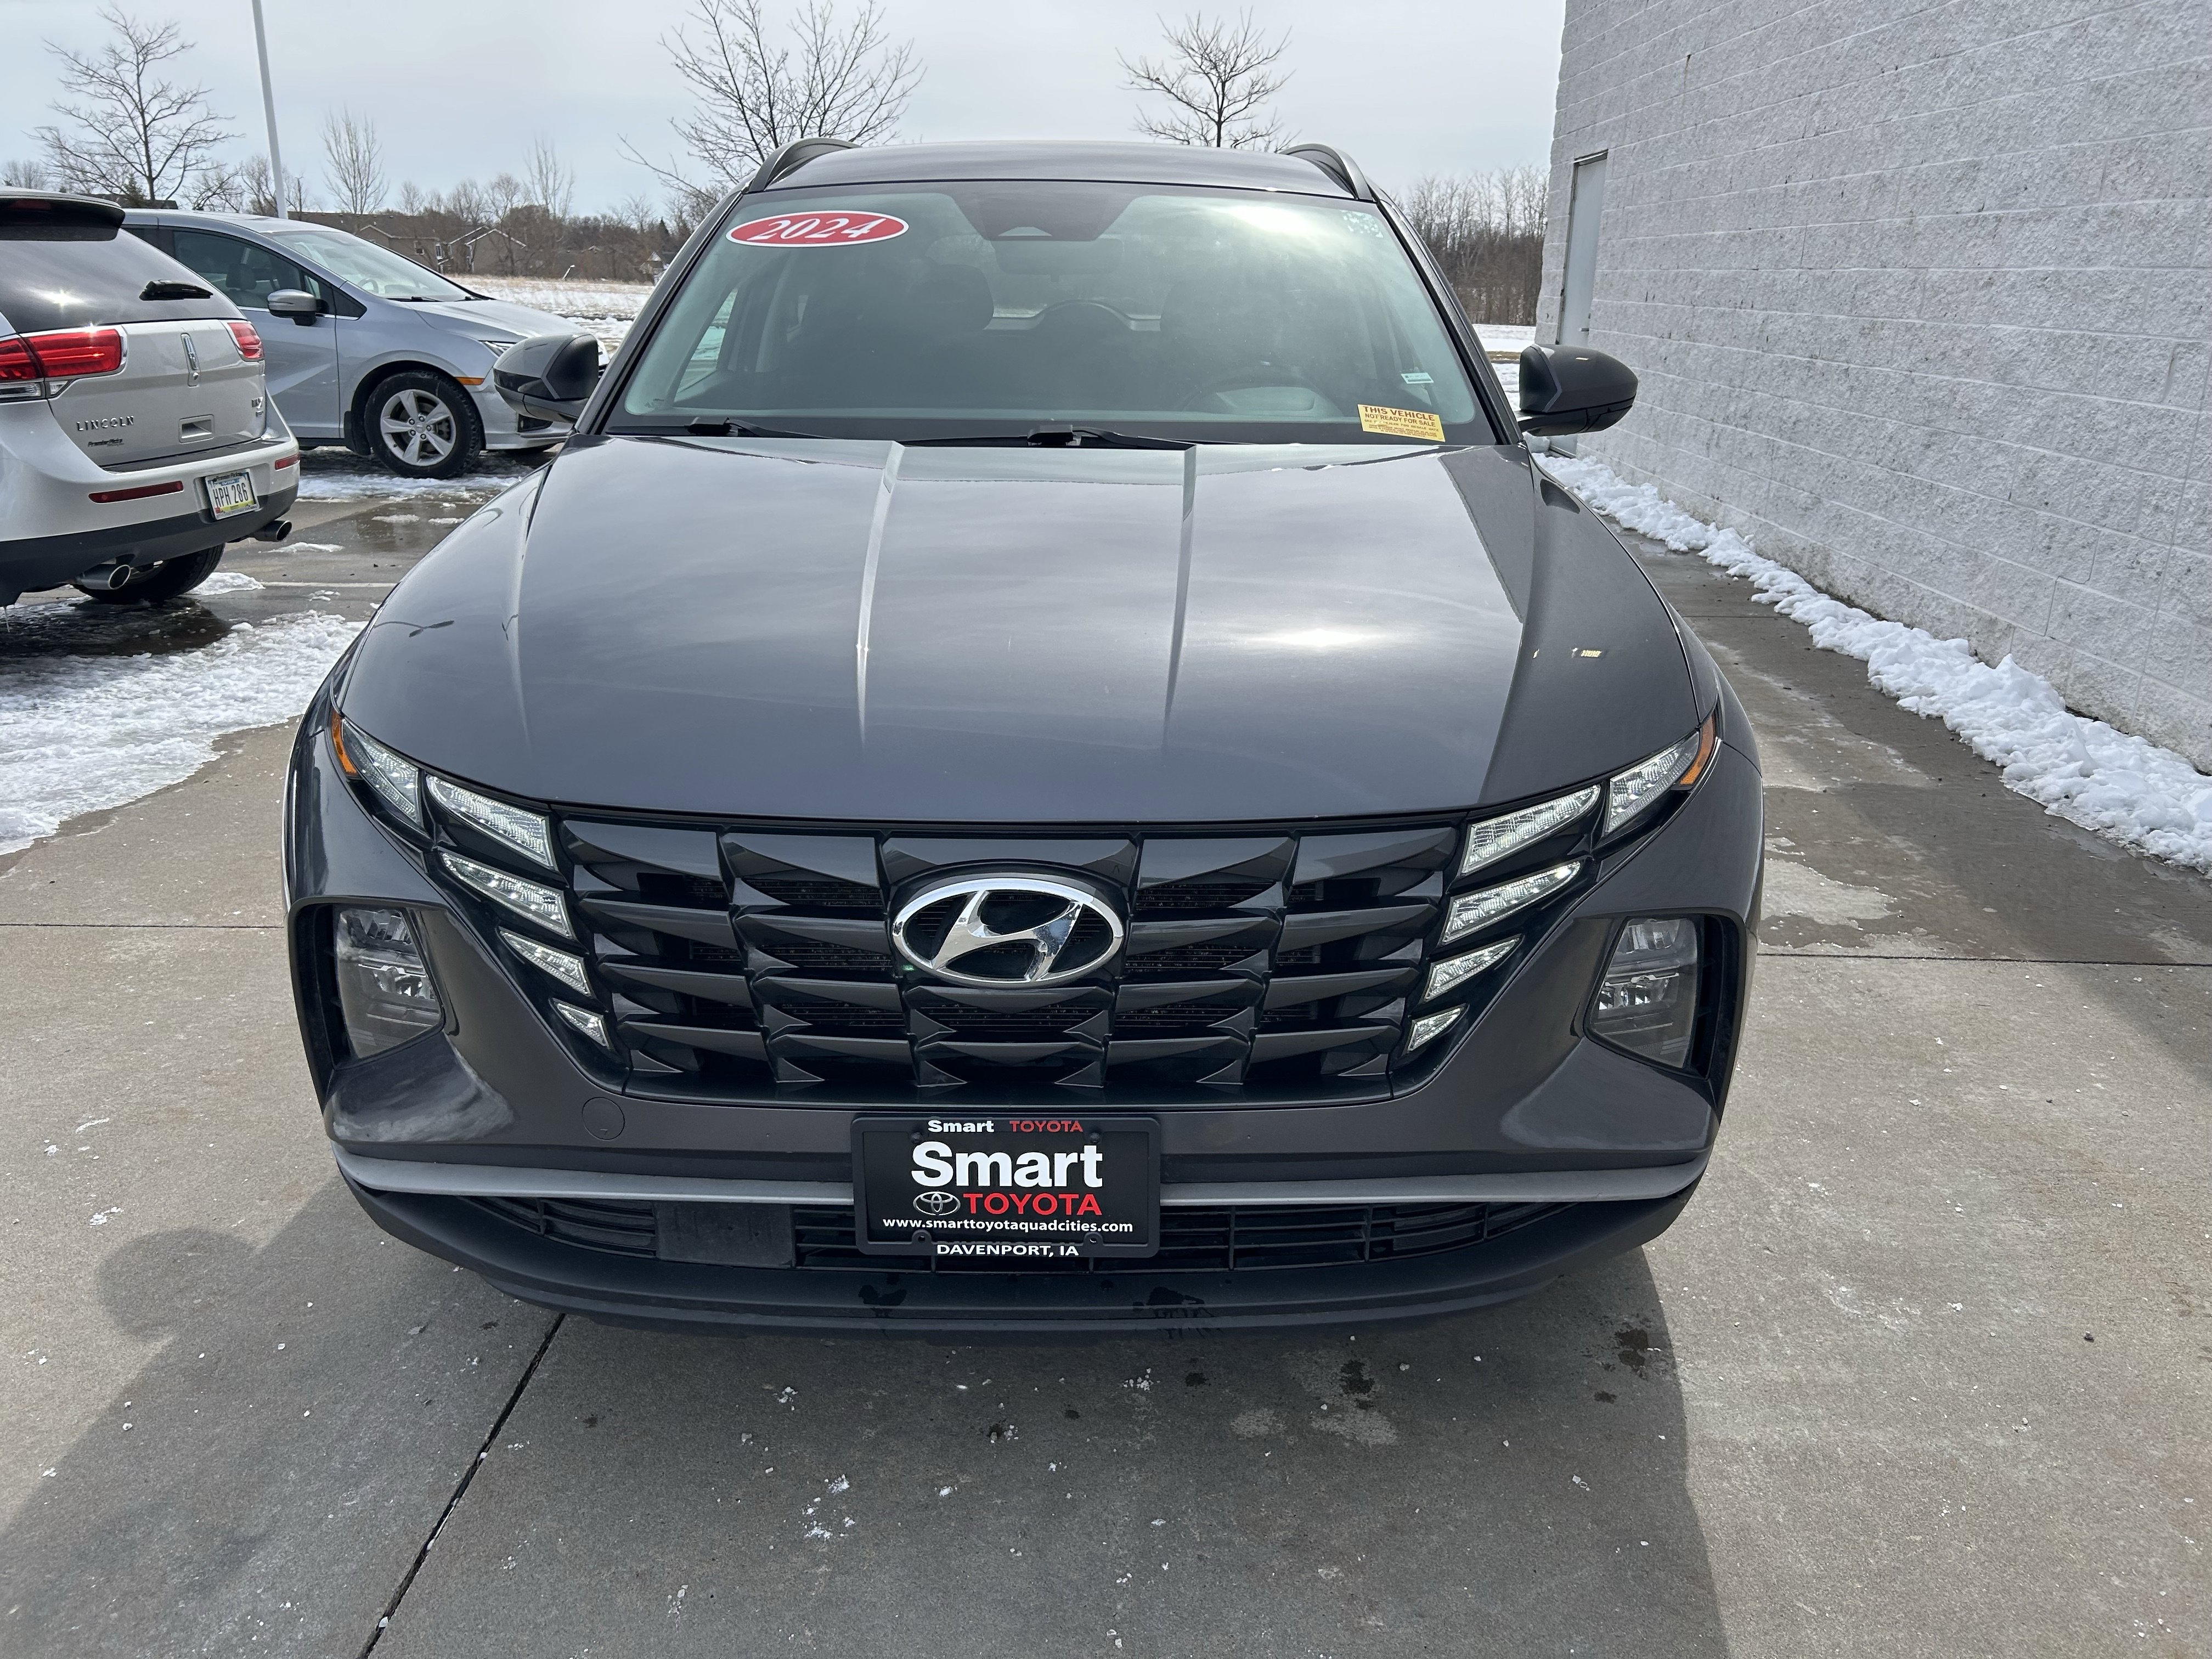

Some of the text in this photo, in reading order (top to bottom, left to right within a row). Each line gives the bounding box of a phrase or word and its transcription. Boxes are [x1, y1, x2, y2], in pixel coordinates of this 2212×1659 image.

[747, 218, 887, 241] 2024
[1363, 406, 1435, 421] THIS VEHICLE
[1380, 414, 1402, 422] READY
[76, 415, 134, 431] LINCOLN
[213, 482, 249, 507] HPH 286
[928, 1120, 1084, 1133] Smart TOYOTA
[911, 1141, 1103, 1188] Smart
[963, 1193, 1103, 1216] TOYOTA
[883, 1218, 1133, 1233] www.smarttoyotaquadcities.com
[936, 1244, 1079, 1257] DAVENPORT, IA
